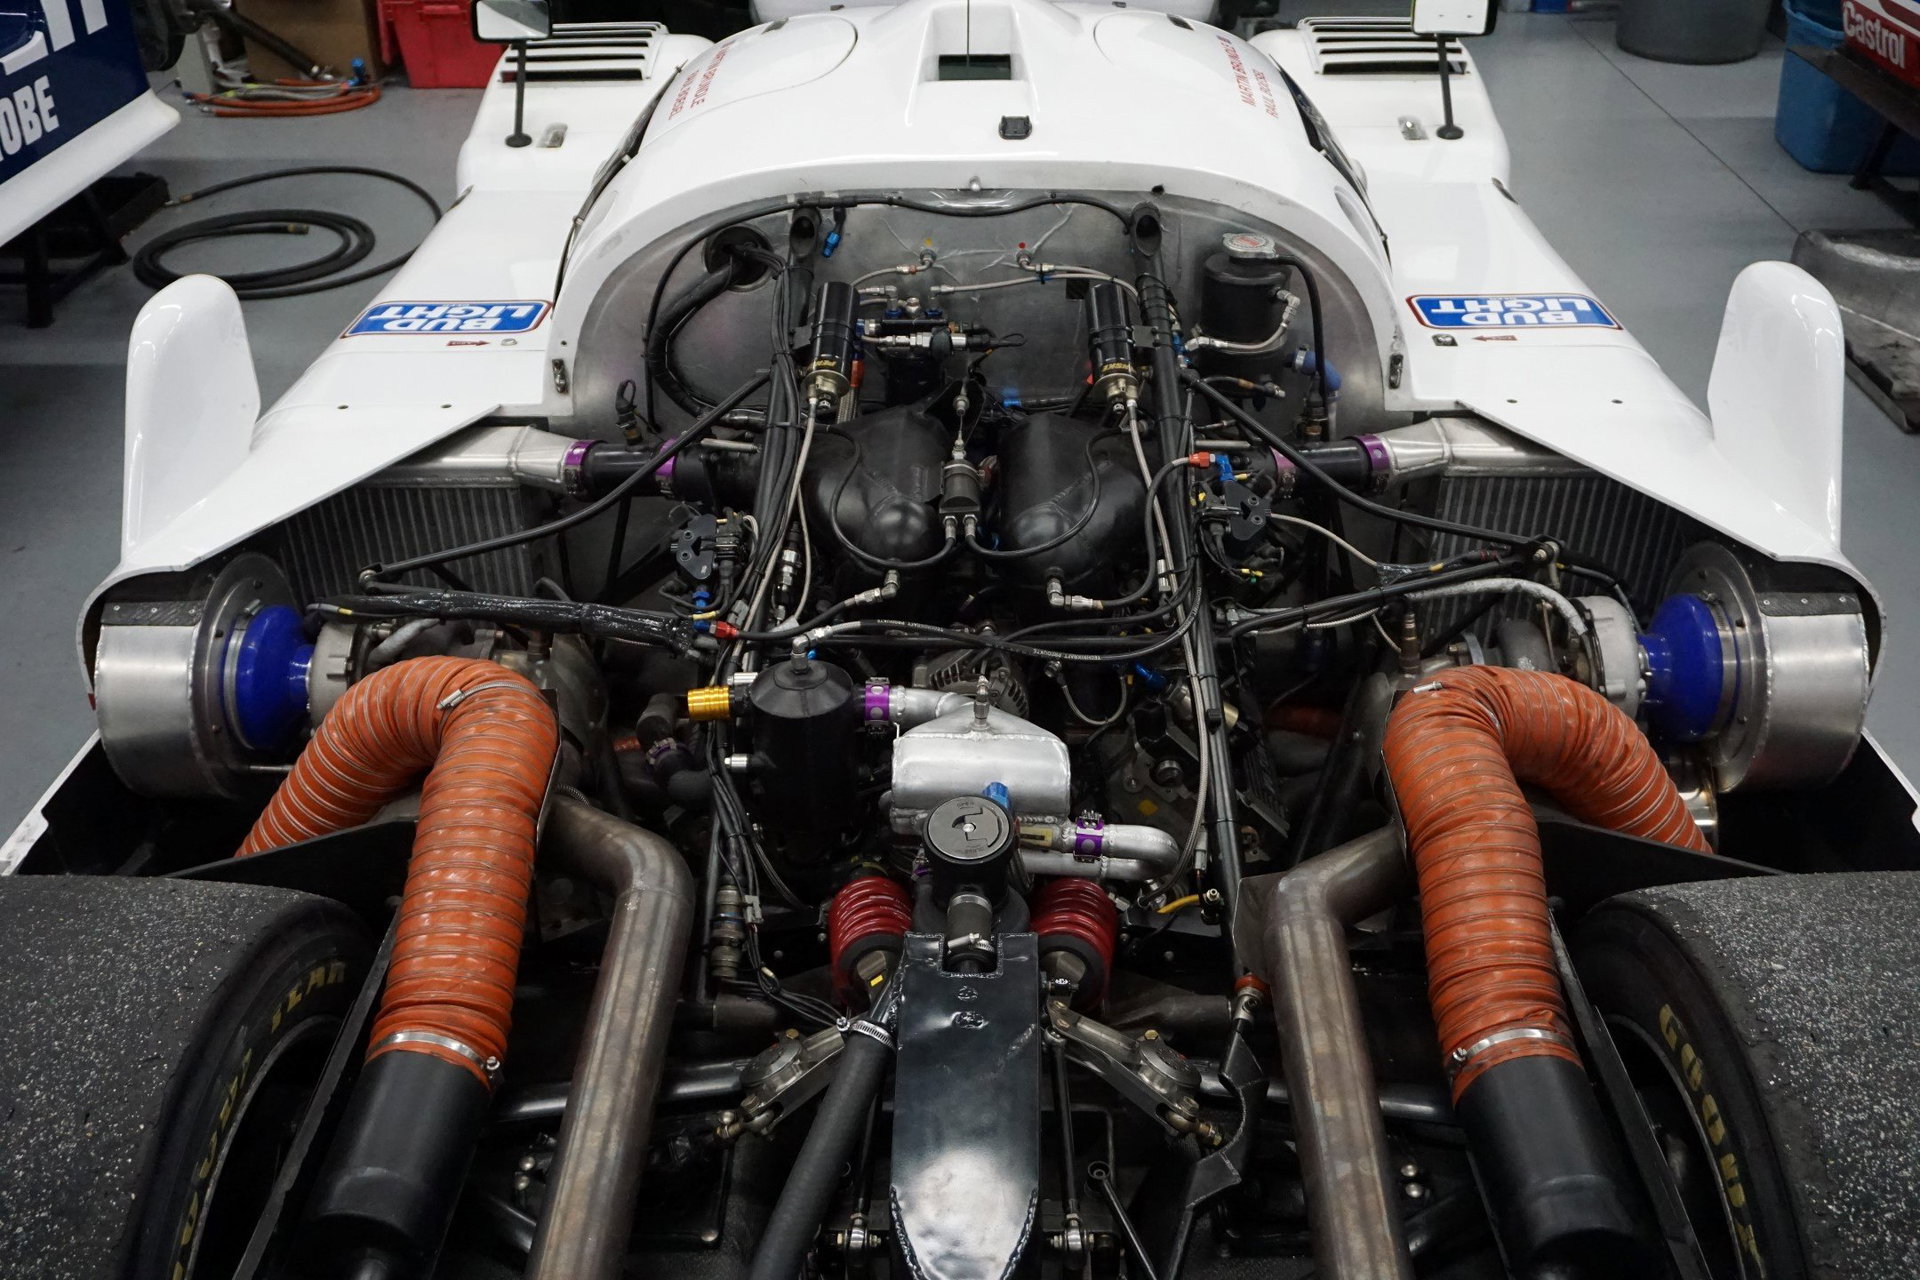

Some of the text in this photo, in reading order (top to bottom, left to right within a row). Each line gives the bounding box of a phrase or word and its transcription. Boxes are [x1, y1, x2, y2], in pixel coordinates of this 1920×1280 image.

[1843, 1, 1905, 69] Castrol
[0, 76, 60, 162] OBE
[367, 305, 535, 320] LIGHT
[1430, 298, 1592, 313] LIGHT
[383, 317, 502, 331] BUD
[1461, 310, 1578, 325] BUD
